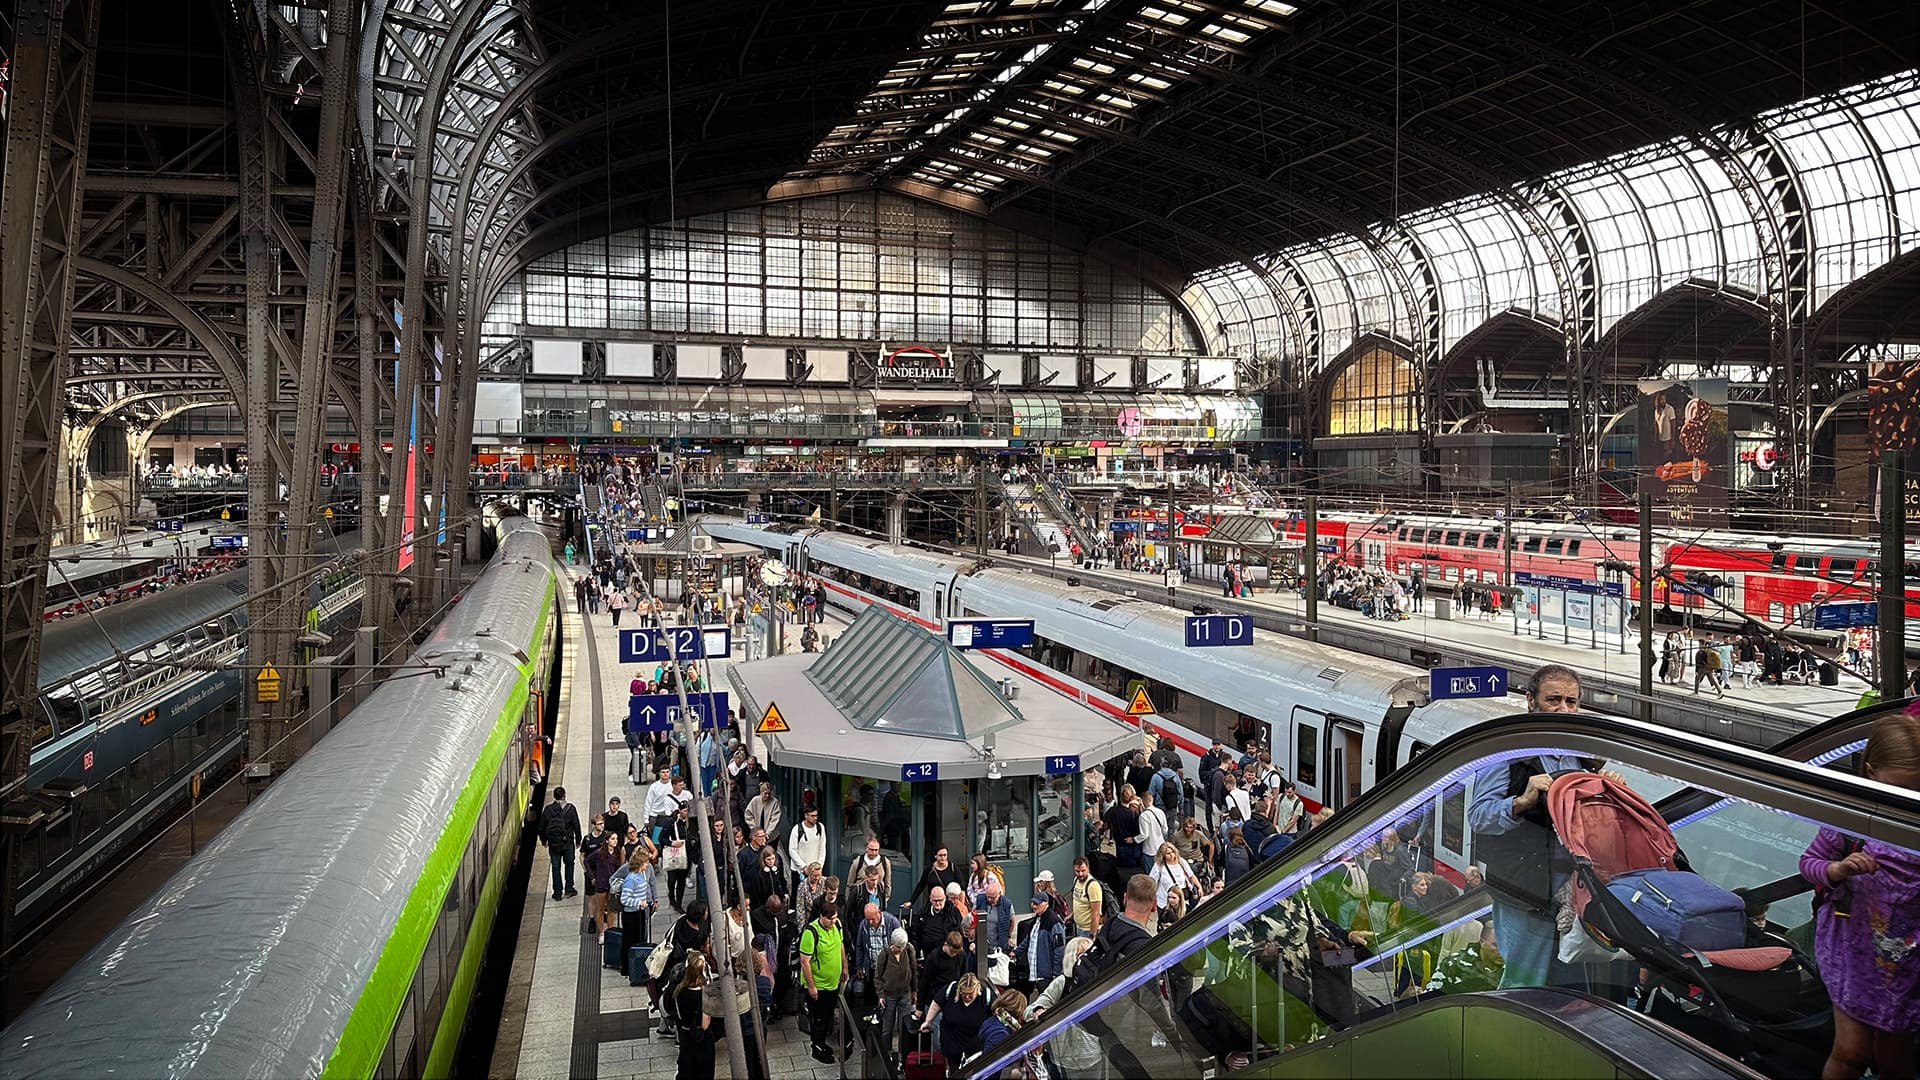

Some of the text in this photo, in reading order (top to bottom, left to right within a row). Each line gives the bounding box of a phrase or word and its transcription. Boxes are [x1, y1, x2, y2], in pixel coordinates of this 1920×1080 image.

[877, 367, 955, 379] WANDELHALLE
[156, 521, 178, 530] 14 E
[1191, 618, 1243, 640] 11 D
[631, 632, 649, 655] D
[1260, 726, 1268, 743] 2
[1053, 757, 1064, 769] 11
[919, 764, 932, 776] 12
